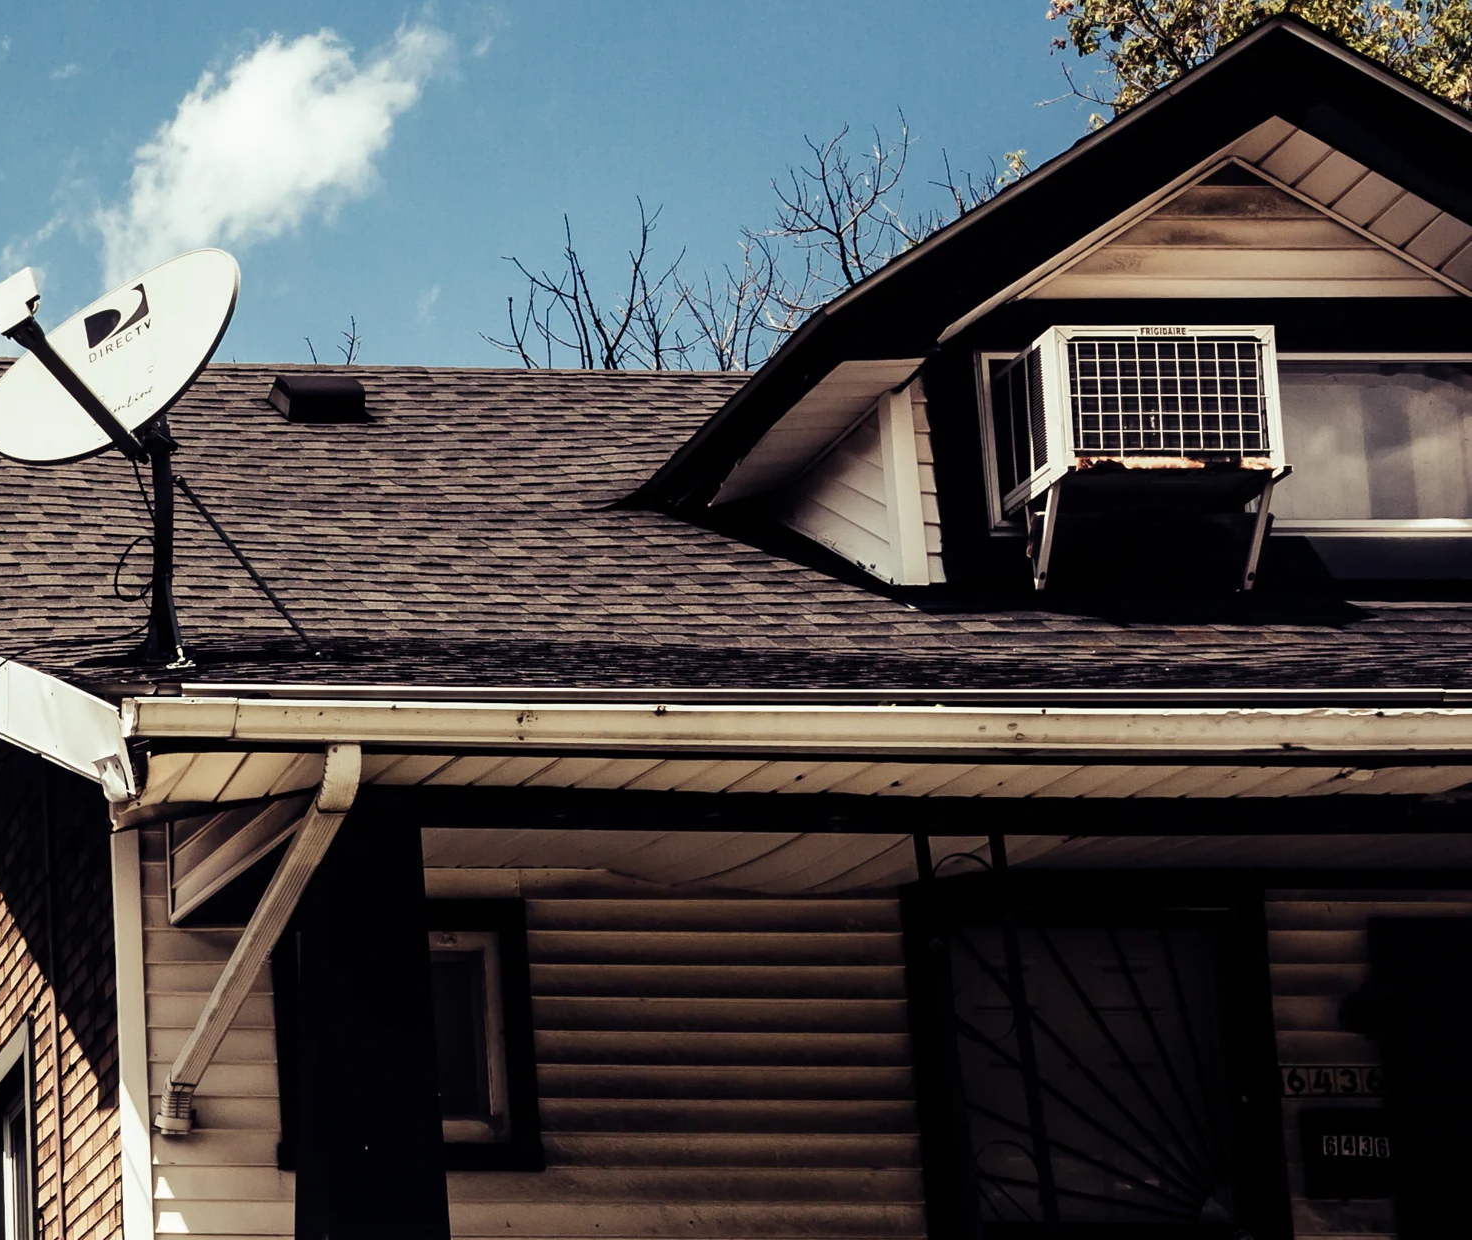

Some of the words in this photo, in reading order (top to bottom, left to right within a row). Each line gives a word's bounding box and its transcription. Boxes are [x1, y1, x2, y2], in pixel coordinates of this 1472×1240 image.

[88, 318, 152, 363] DIRECTV
[1140, 327, 1186, 335] FRIGIDAIRE
[1288, 1068, 1381, 1095] 6436
[1325, 1136, 1388, 1157] 6436
